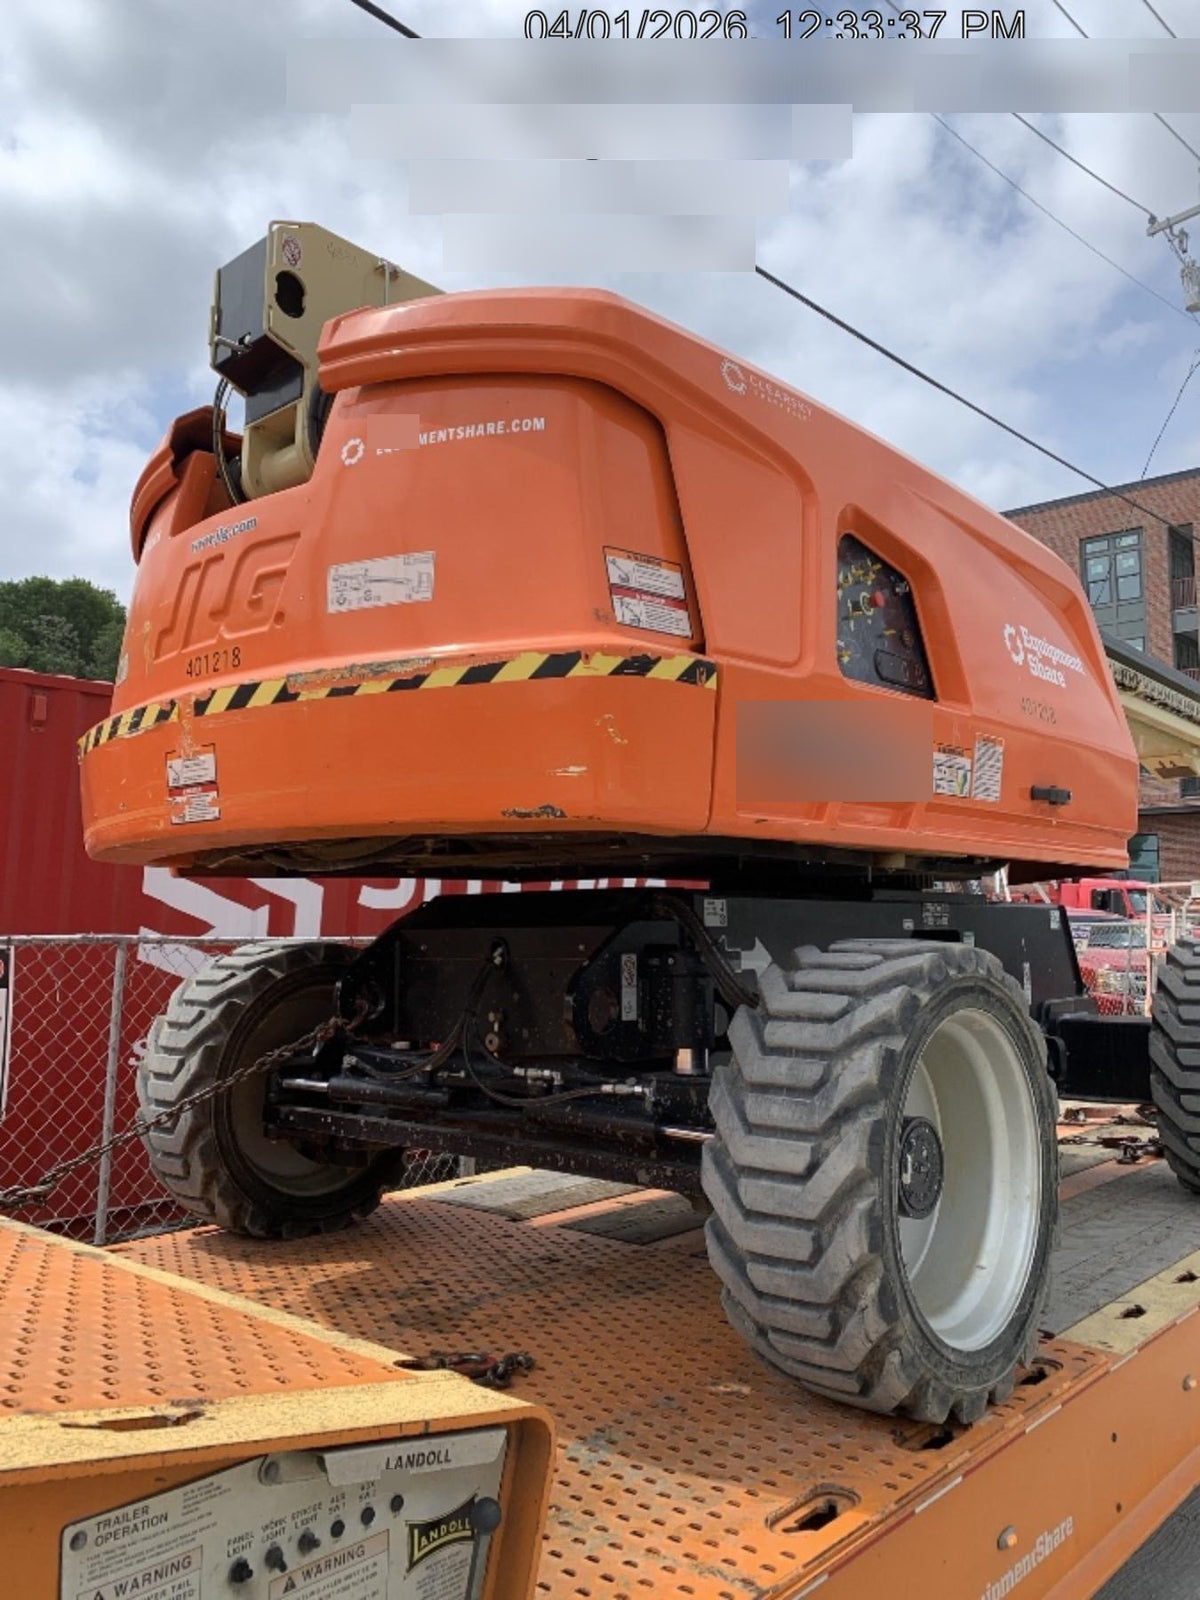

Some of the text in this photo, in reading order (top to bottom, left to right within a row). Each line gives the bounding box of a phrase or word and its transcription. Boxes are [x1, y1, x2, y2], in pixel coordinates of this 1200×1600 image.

[376, 417, 546, 456] MENTSHARE.COM
[186, 646, 242, 678] 401218
[1019, 625, 1086, 676] Equipment
[1026, 651, 1067, 688] Share
[385, 1449, 452, 1471] LANDOLL
[95, 1505, 150, 1533] TRAILER
[95, 1512, 168, 1547] OPERATION
[227, 1531, 255, 1547] PANEL
[227, 1540, 253, 1558] LIGHT
[413, 1516, 471, 1562] LANDOLL
[114, 1555, 193, 1598] WARNING
[302, 1545, 366, 1581] WARNING
